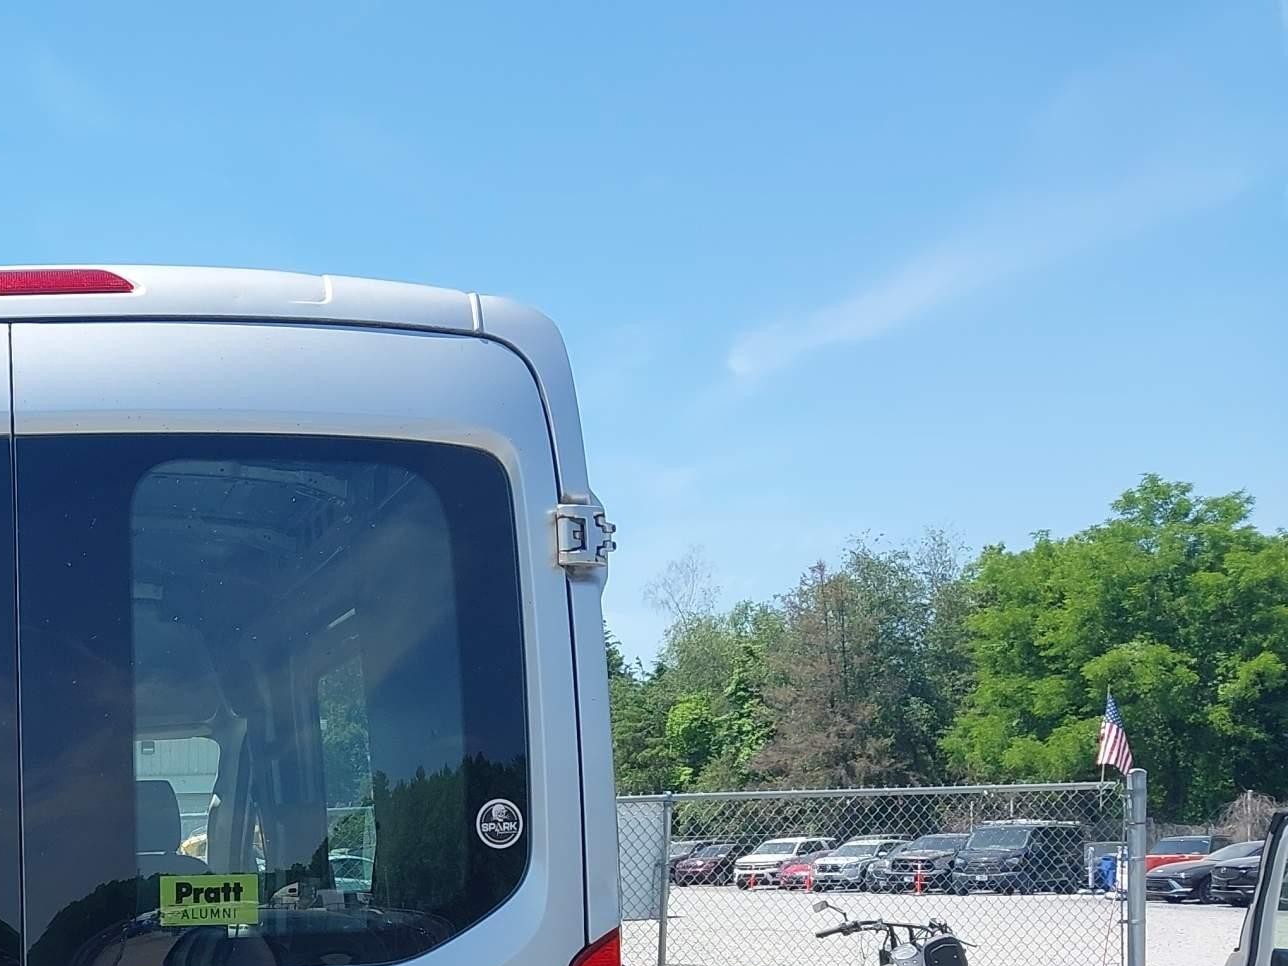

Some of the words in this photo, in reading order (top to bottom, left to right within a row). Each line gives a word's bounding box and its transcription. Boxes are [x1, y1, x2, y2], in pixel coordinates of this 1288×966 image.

[481, 822, 518, 832] SPARK
[175, 881, 244, 904] Pratt
[180, 908, 237, 919] ALUMNI
